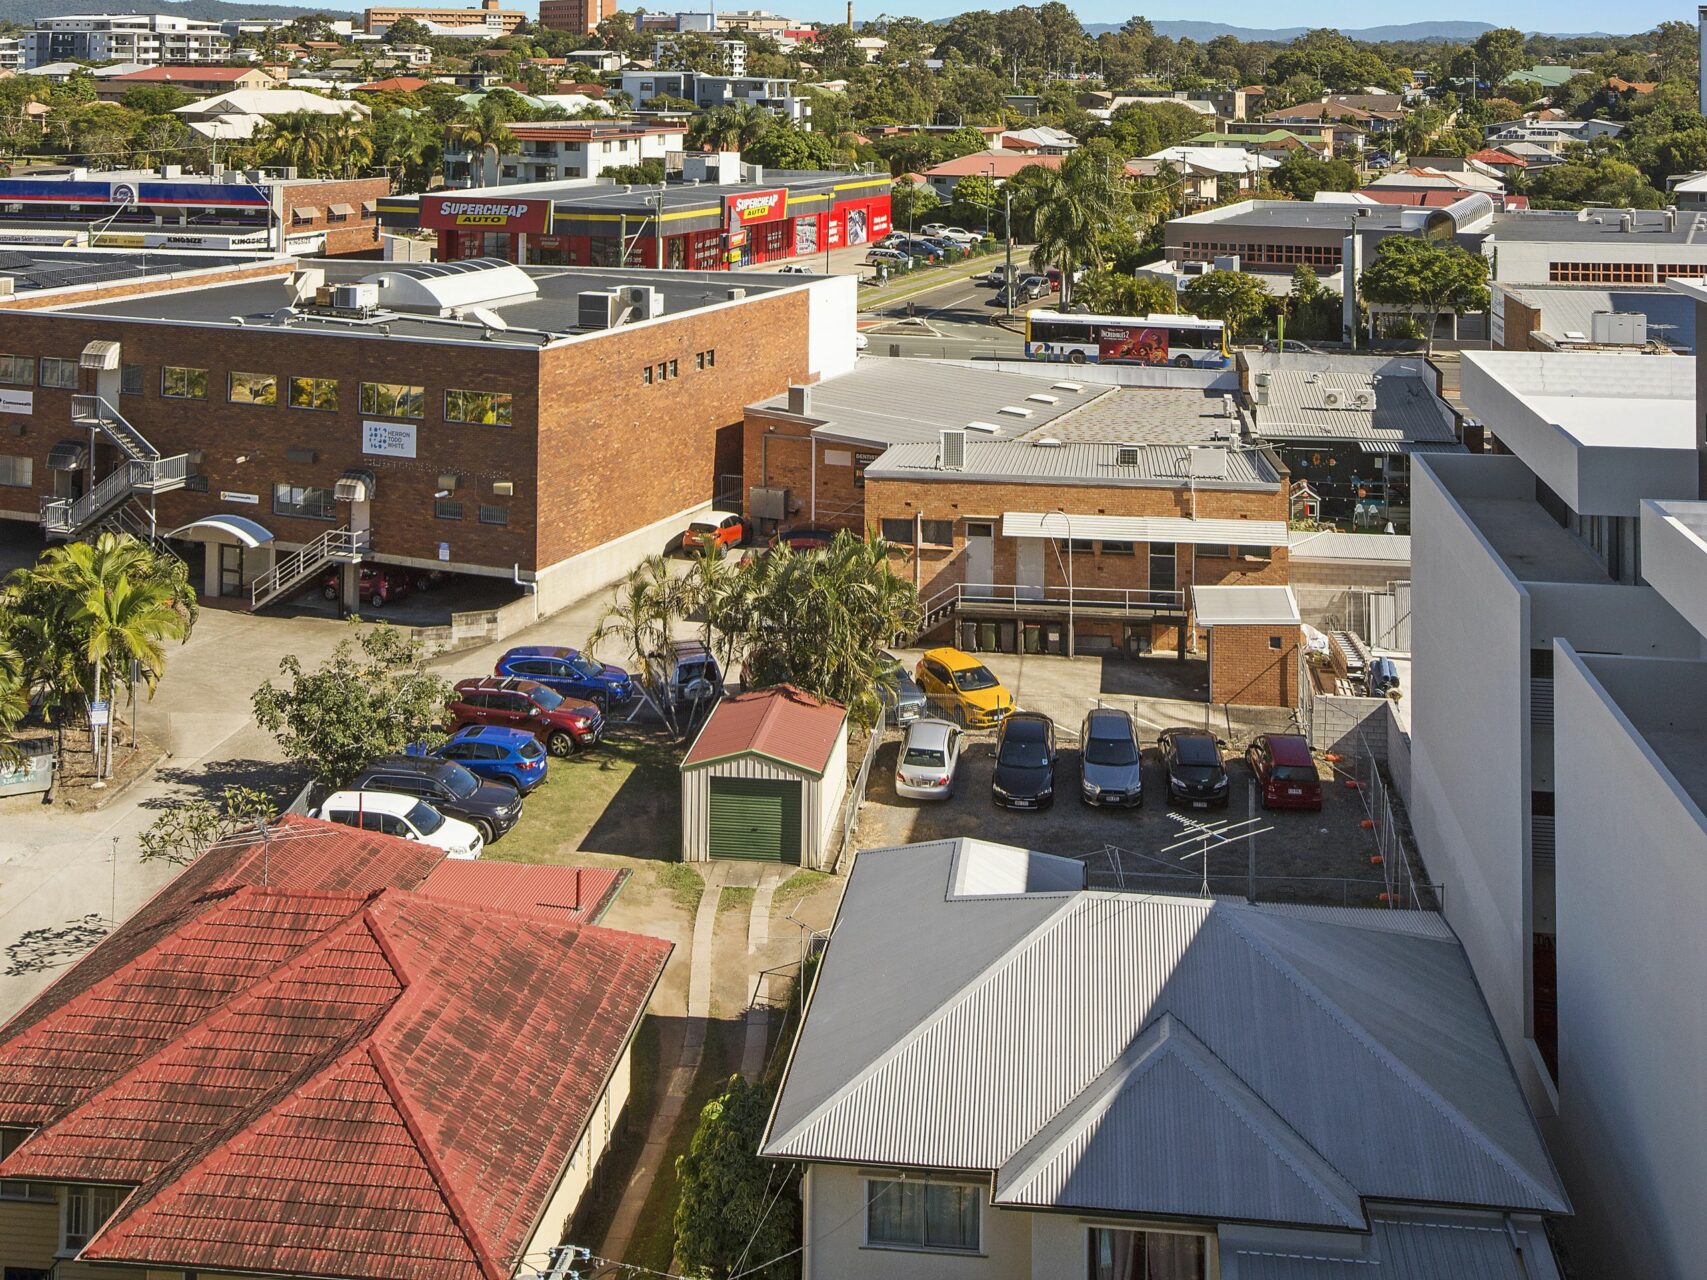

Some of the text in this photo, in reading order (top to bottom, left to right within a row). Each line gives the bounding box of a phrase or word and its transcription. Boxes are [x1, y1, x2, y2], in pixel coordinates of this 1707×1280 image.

[259, 186, 269, 194] 74
[736, 194, 779, 212] SUPERCHEAP
[440, 201, 528, 218] SUPERCHEAP
[747, 207, 766, 216] AUTO
[167, 236, 203, 244] KINGSIZE
[1101, 329, 1126, 338] INCREDIBLES
